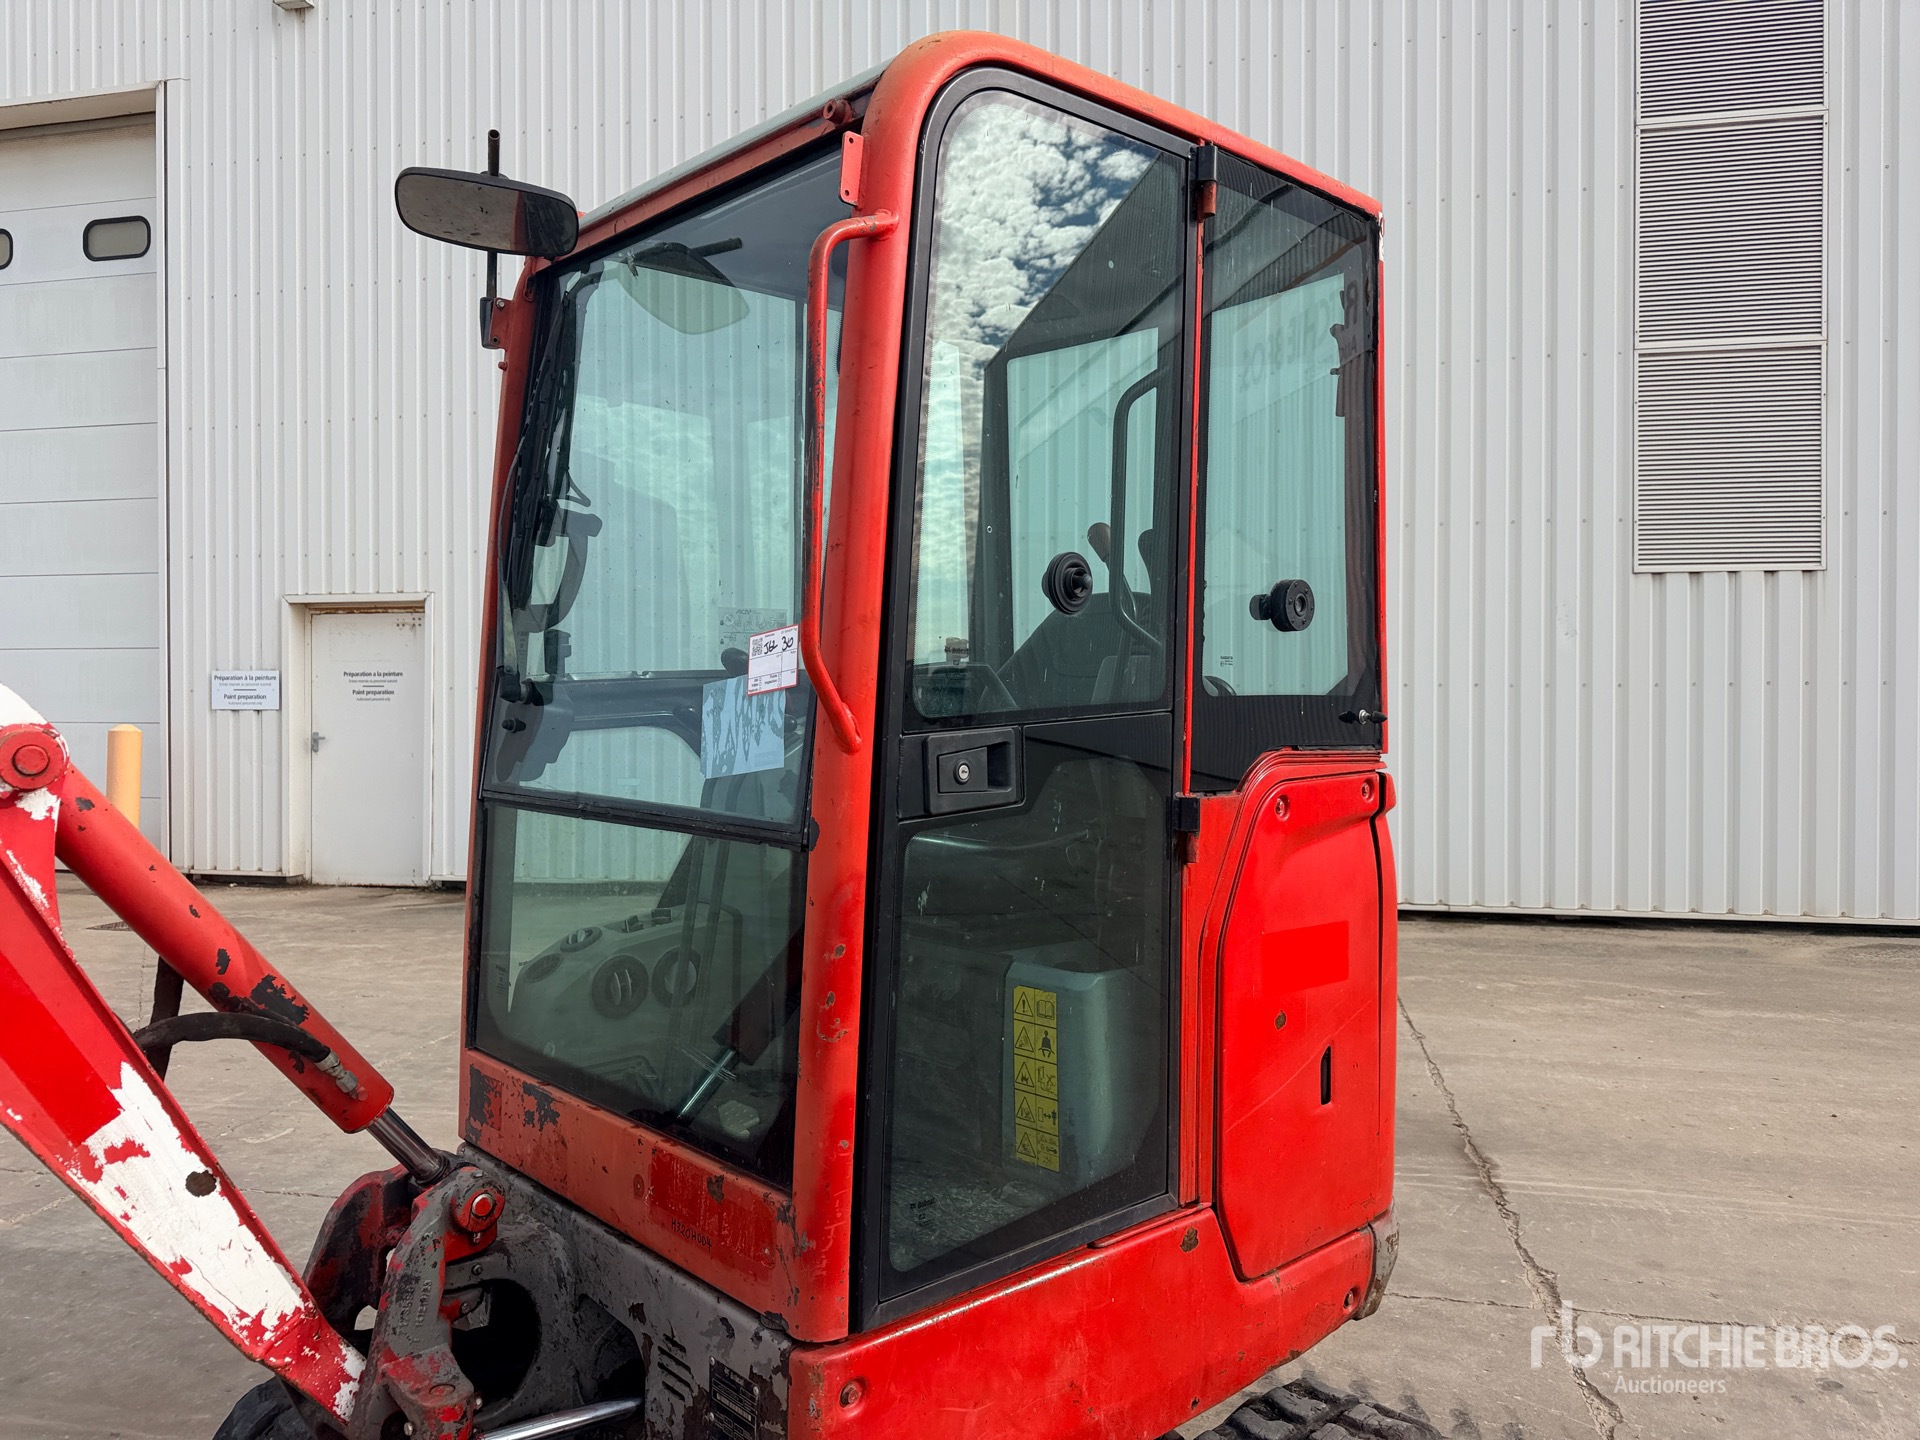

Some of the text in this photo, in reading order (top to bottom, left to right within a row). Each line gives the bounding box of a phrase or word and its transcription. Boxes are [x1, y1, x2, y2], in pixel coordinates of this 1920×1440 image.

[213, 674, 243, 682] Préparation
[254, 674, 277, 682] peinture
[382, 670, 404, 678] peinture
[237, 693, 267, 701] preparation
